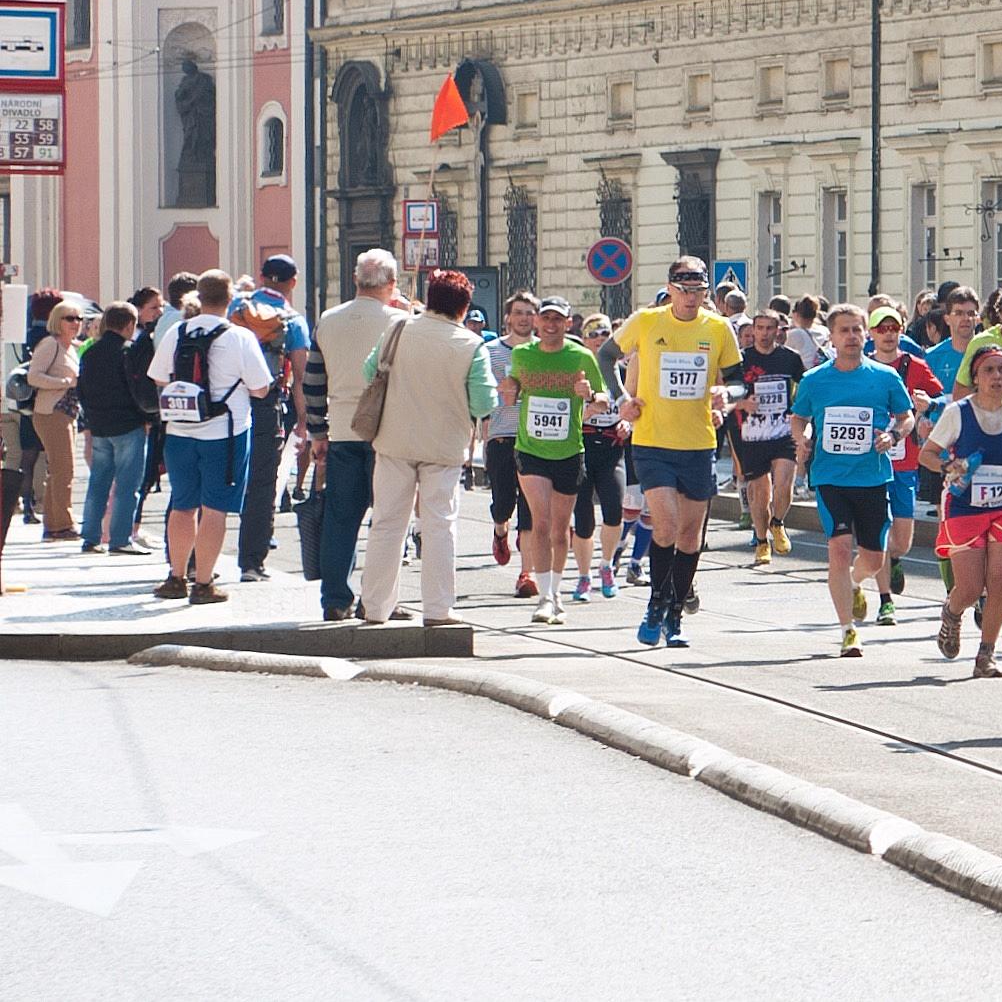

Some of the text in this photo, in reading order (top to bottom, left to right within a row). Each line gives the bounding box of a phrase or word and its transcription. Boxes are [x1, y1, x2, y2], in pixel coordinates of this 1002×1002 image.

[2, 109, 41, 117] DIVADLO
[15, 119, 54, 131] 22 58
[14, 133, 54, 145] 53 59
[14, 147, 30, 159] 57
[670, 372, 698, 385] 5177
[167, 397, 188, 409] 307
[534, 415, 563, 427] 5941
[830, 426, 865, 440] 5293
